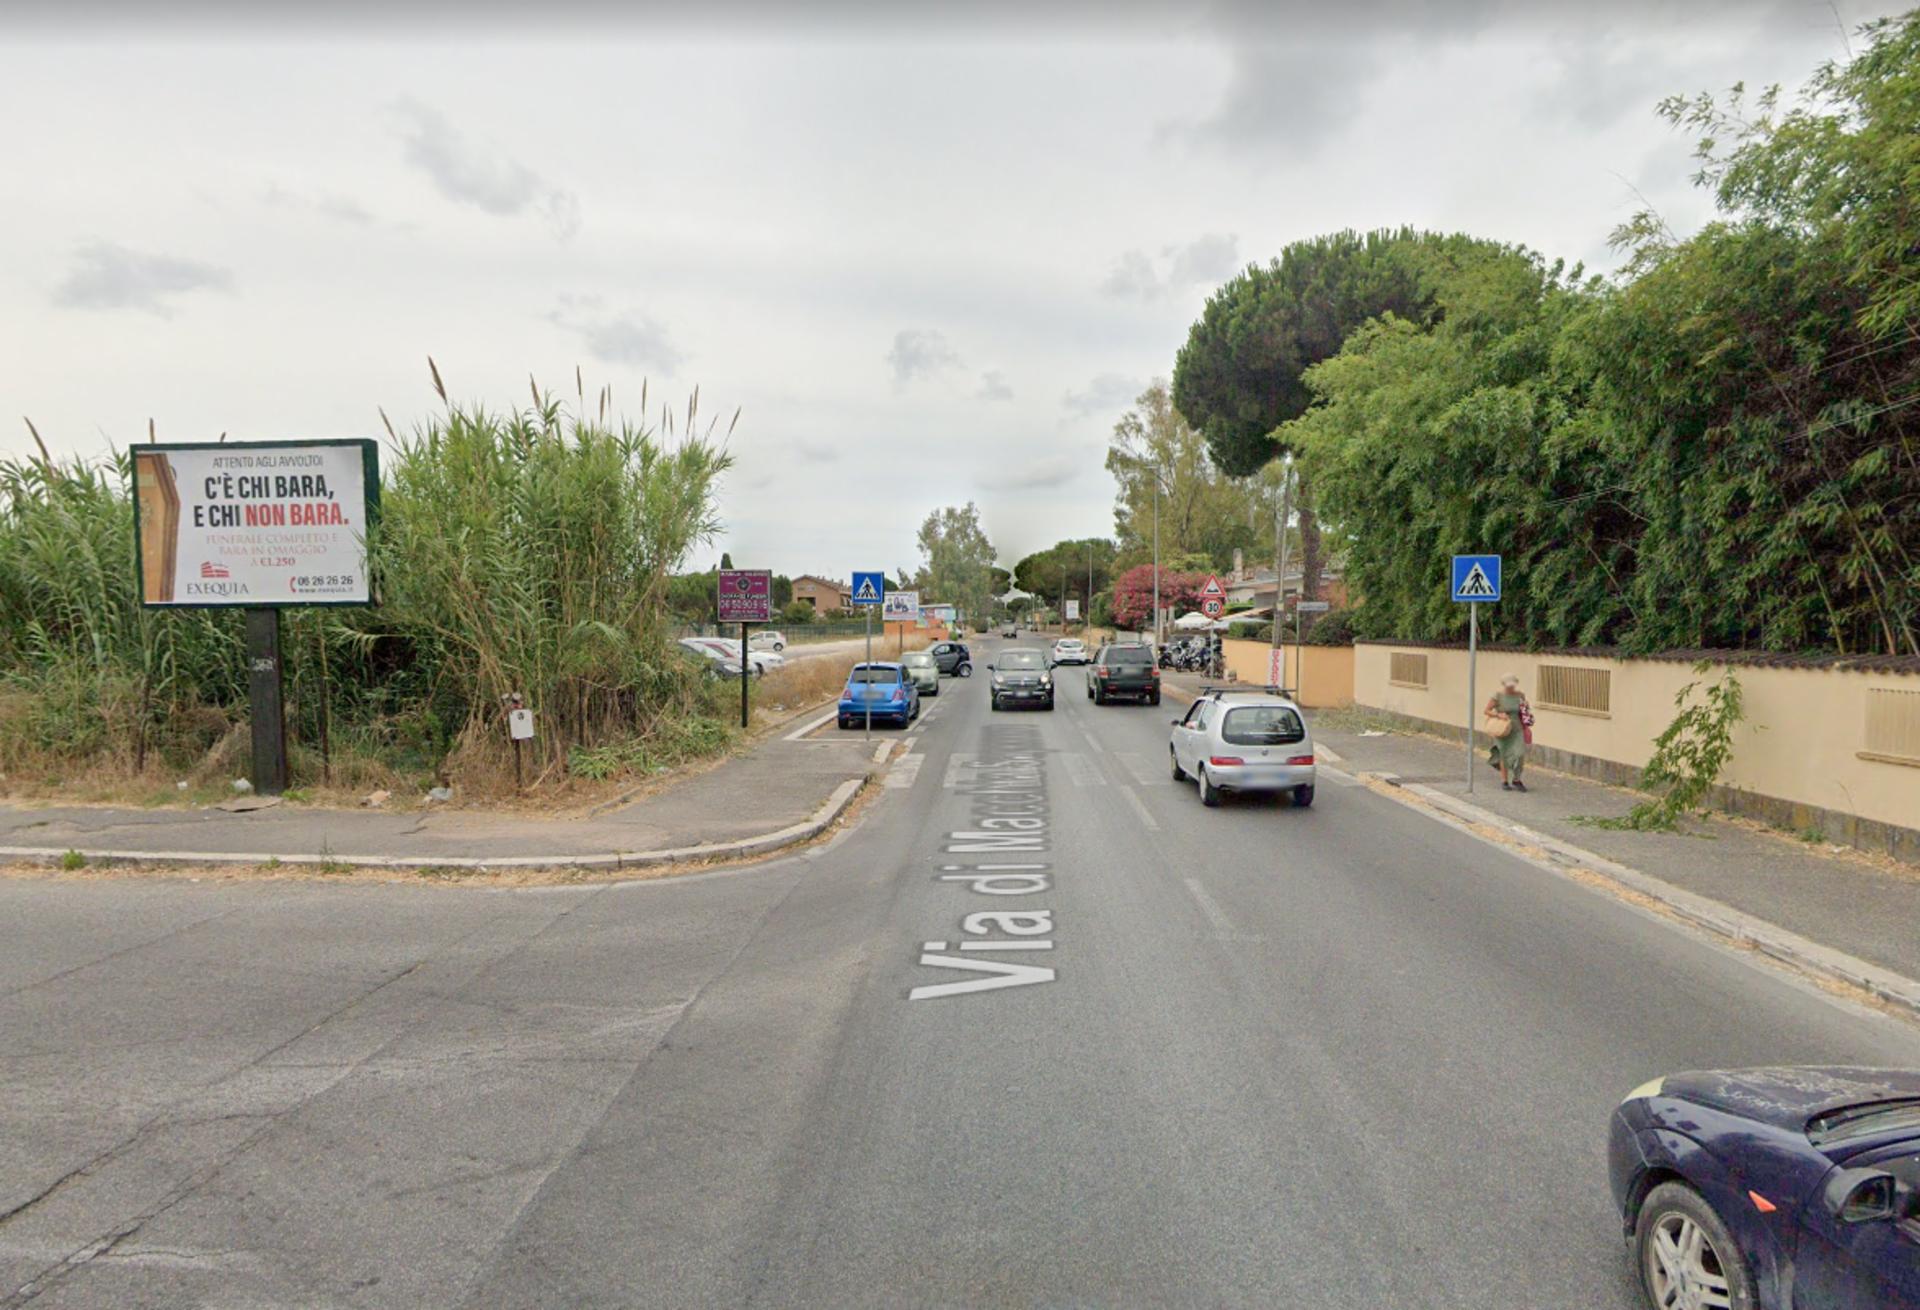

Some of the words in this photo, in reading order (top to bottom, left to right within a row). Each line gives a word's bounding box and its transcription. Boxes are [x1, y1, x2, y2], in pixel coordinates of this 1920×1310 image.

[213, 456, 253, 468] ATTENTO
[255, 456, 276, 467] AGLI
[279, 455, 323, 467] AVVOLTOI
[204, 472, 234, 499] C'È
[238, 475, 270, 498] CHI
[275, 474, 334, 499] BARA,
[194, 505, 204, 527] E
[208, 504, 240, 527] CHI
[245, 503, 285, 527] NON
[290, 502, 349, 526] BARA.
[207, 534, 262, 545] FUNERALE
[265, 533, 329, 544] COMPLETO
[251, 545, 263, 555] IN
[266, 544, 327, 555] OMAGGIO
[187, 582, 249, 597] EXEQUIA
[1207, 603, 1219, 612] 30
